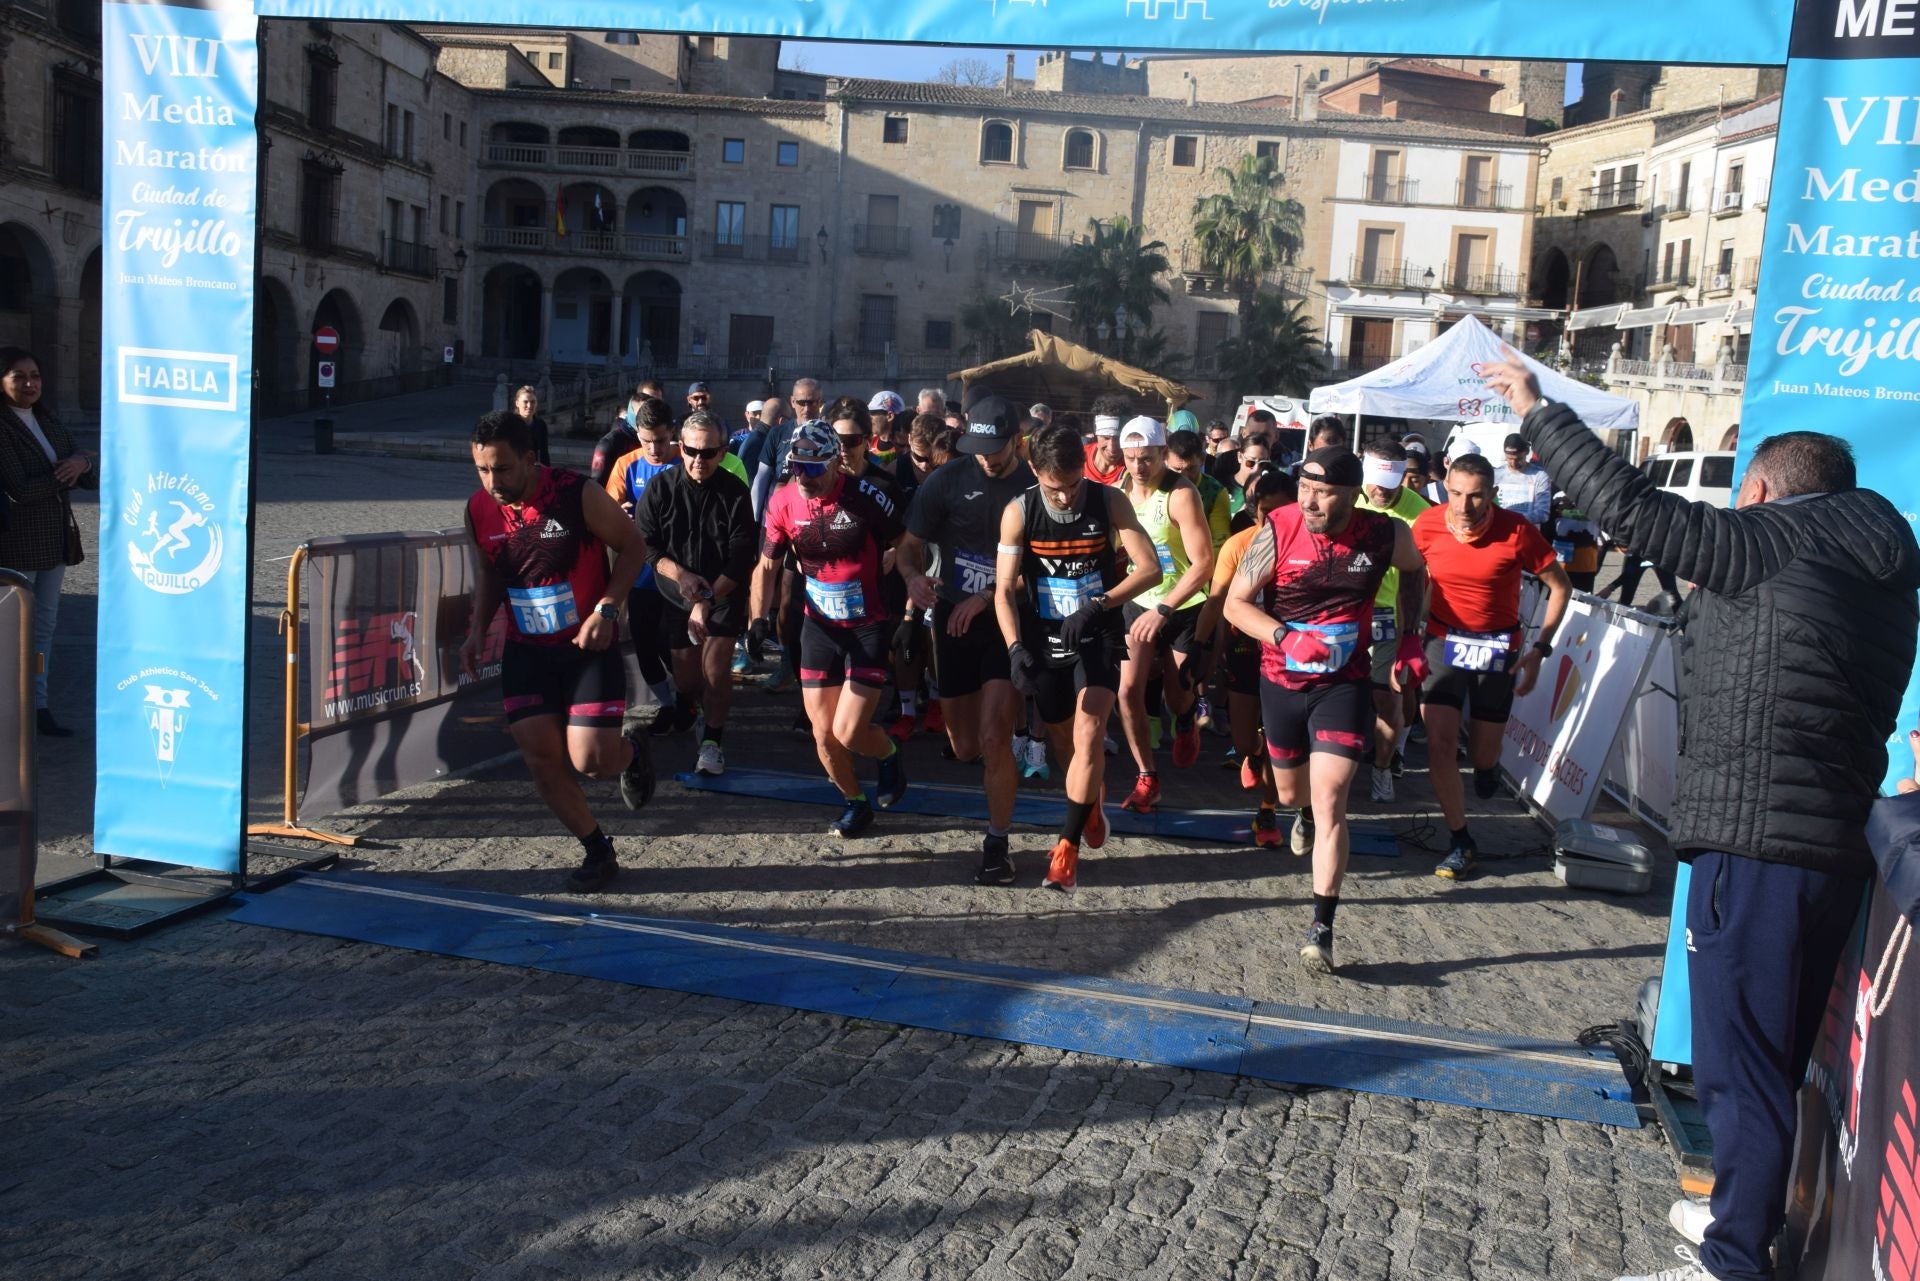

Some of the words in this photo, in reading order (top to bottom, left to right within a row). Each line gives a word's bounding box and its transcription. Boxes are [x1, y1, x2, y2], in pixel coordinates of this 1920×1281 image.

[129, 33, 223, 78] VIII
[122, 91, 236, 126] Media
[115, 139, 247, 173] Maratón
[131, 181, 201, 206] Ciudad
[203, 188, 228, 208] de
[1801, 167, 1920, 203] Med
[115, 209, 241, 269] Trujillo
[1783, 223, 1920, 259] Marat
[119, 272, 144, 285] Juan
[147, 274, 183, 287] Mateos
[186, 276, 237, 290] Broncano
[1802, 272, 1905, 301] Ciudad
[133, 364, 219, 394] HABLA
[1773, 380, 1809, 395] Juan
[1813, 382, 1870, 398] Mateos
[970, 422, 997, 436] HOKA
[123, 487, 143, 527] Club
[148, 471, 216, 513] Atletismo
[859, 479, 895, 518] trail
[135, 563, 200, 590] TRUJILLO
[1065, 559, 1097, 571] VICKY
[520, 604, 561, 634] 561
[1452, 643, 1493, 671] 240
[117, 674, 138, 691] Club
[140, 666, 178, 678] Athletico
[179, 671, 198, 685] San
[325, 682, 421, 718] www.musicrun.es
